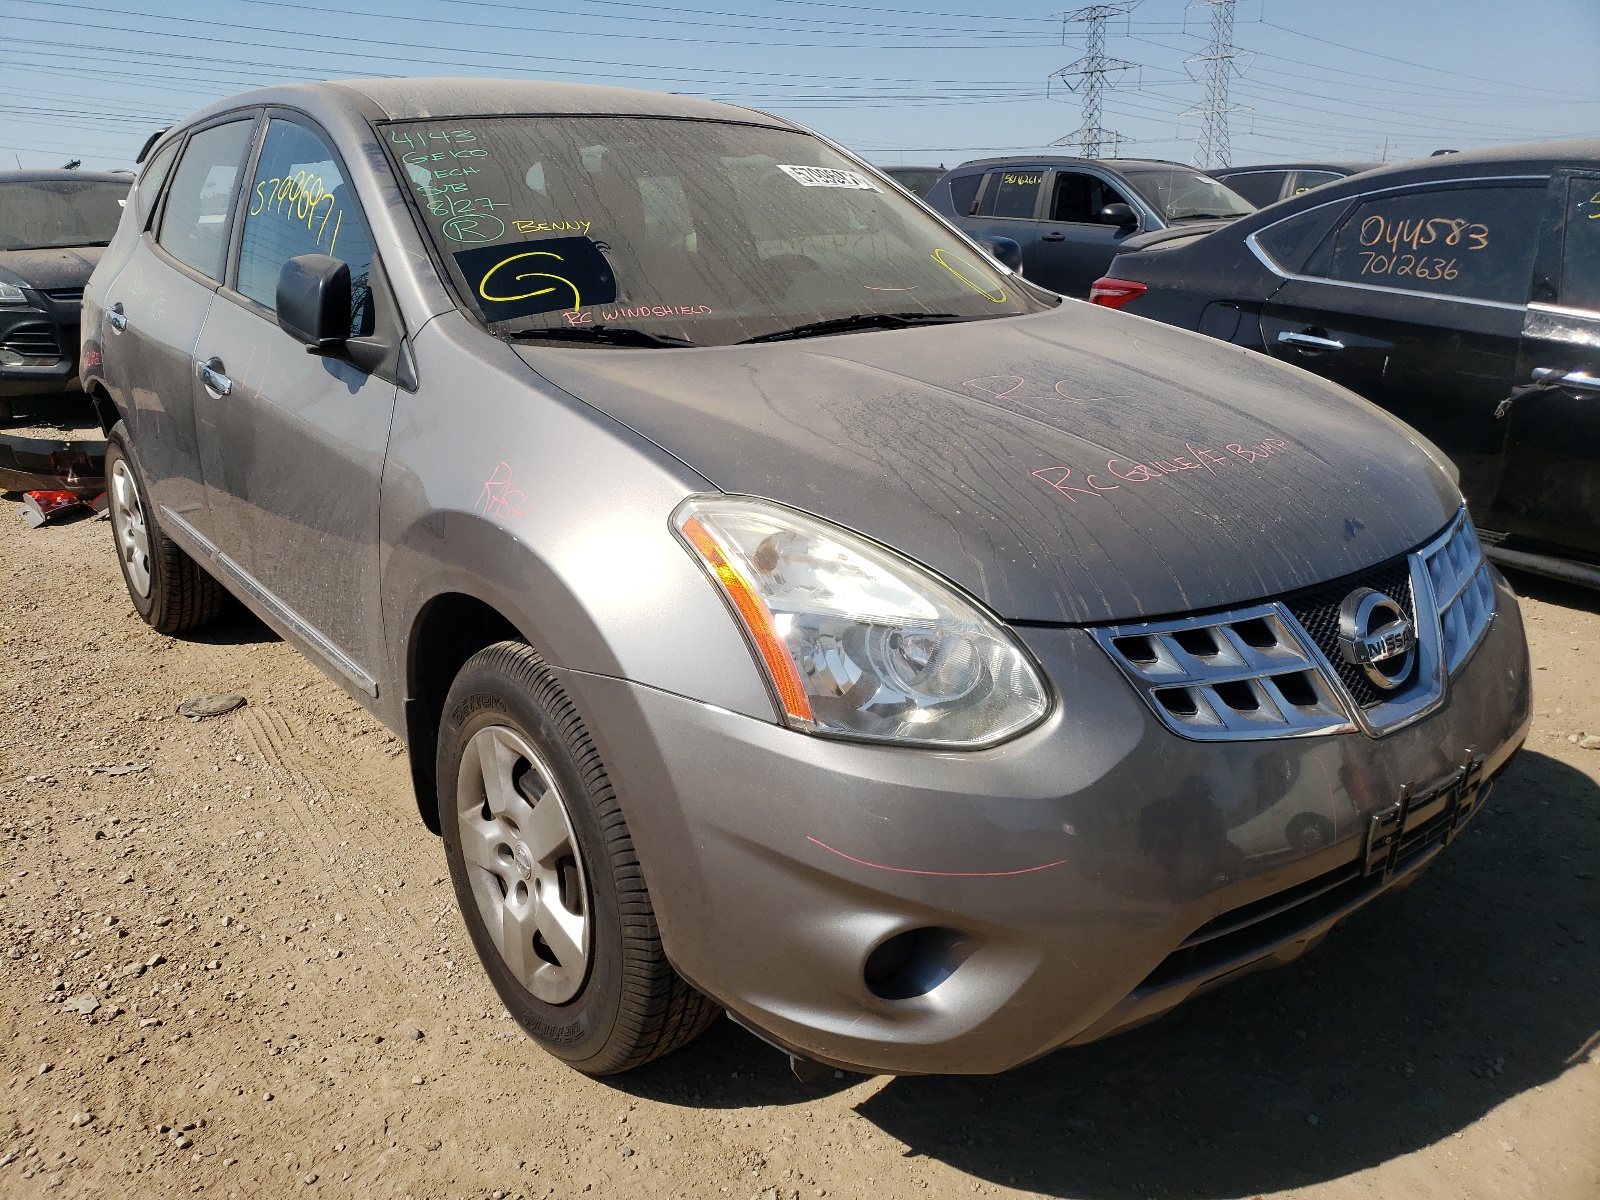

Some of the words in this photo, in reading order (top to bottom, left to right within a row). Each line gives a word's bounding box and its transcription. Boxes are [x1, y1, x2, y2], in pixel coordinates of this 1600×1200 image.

[391, 130, 477, 149] 4143
[402, 149, 489, 164] GEICO
[412, 166, 481, 180] MECH
[512, 220, 591, 235] BENNY
[1359, 215, 1489, 252] 044583
[1358, 251, 1459, 280] 7012636
[562, 310, 593, 326] RC
[602, 305, 712, 320] WINDSHIELD
